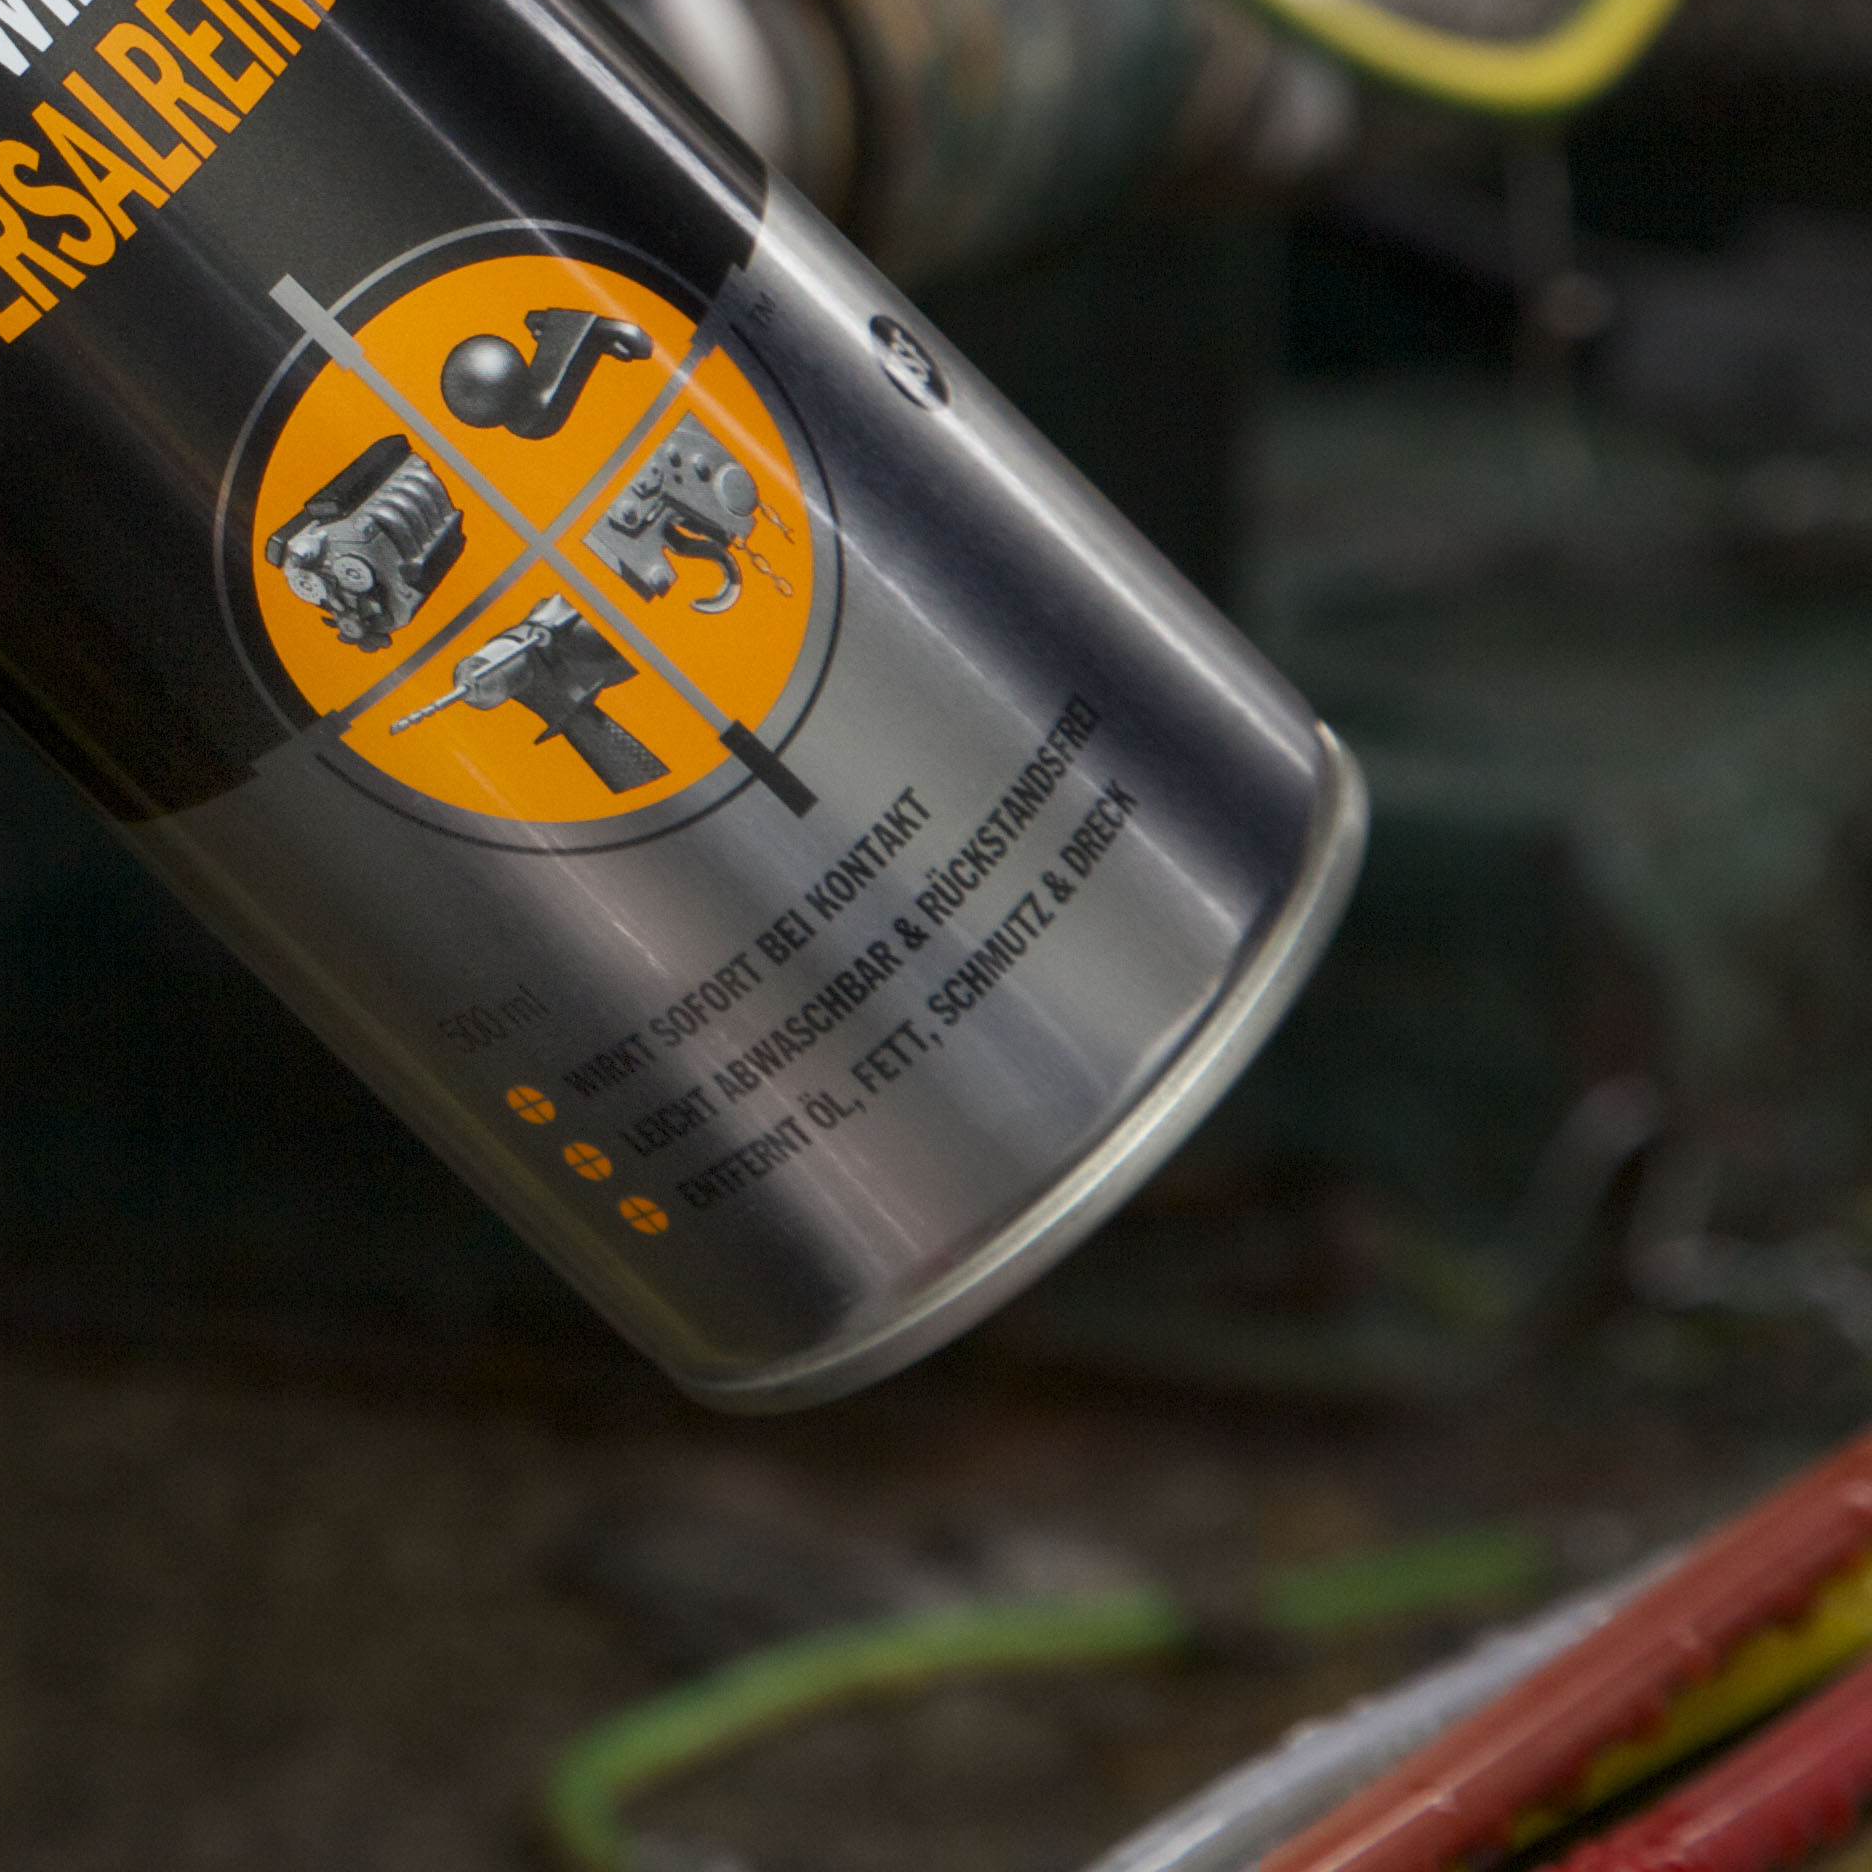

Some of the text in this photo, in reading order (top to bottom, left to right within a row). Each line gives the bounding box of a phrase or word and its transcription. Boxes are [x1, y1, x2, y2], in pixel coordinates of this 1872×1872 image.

[562, 785, 932, 1097] WIRKT SOFORT BEI KONTAKT
[619, 691, 1102, 1157] LEICHT ABWASCHBAR & RÜCKSTANDSFREI
[676, 779, 1140, 1208] ENTFERNT ÖL, FETT, SCHMUTZ & DRECK
